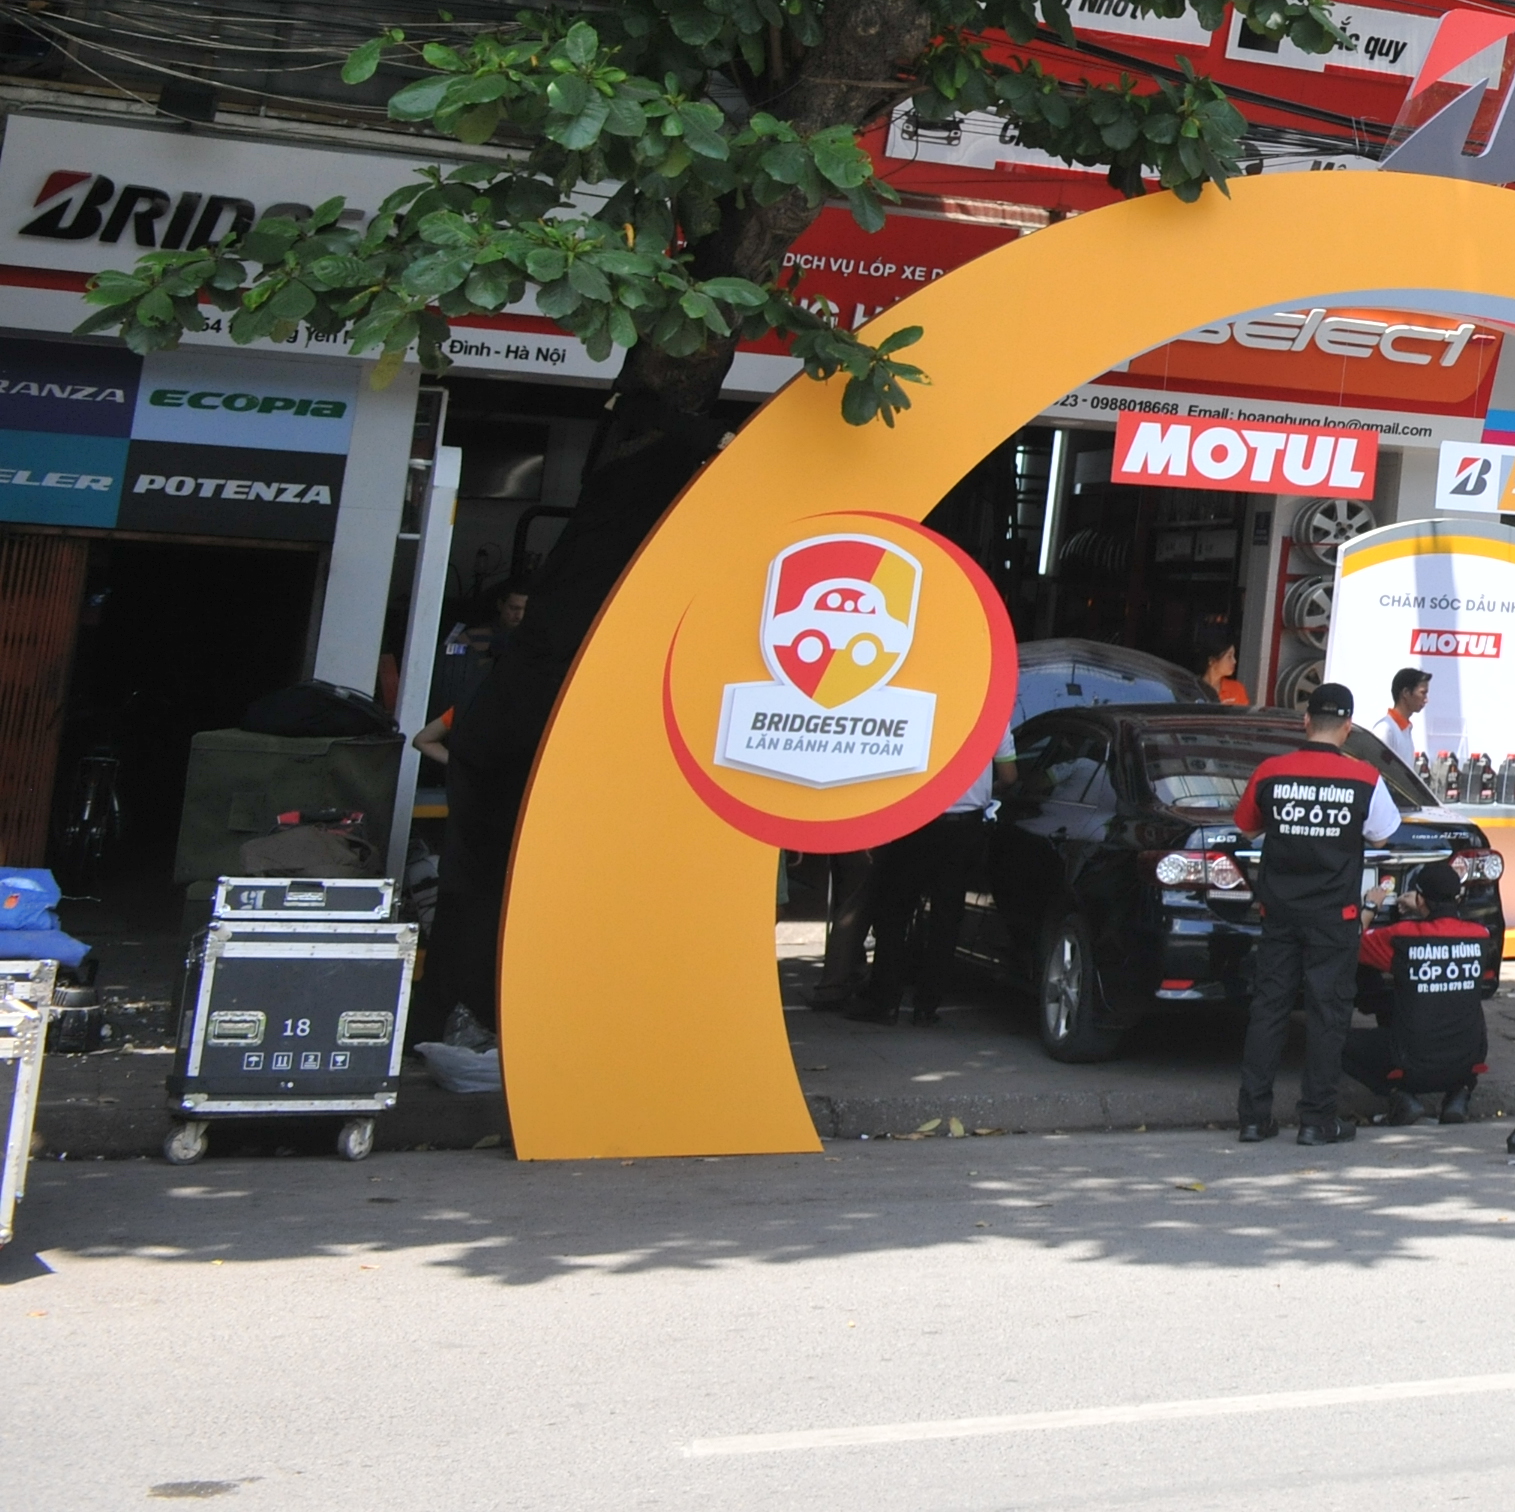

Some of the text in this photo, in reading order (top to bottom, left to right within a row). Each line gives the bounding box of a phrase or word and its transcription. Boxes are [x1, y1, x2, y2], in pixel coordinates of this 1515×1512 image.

[1363, 37, 1407, 64] quy
[829, 258, 855, 277] VỤ
[858, 257, 897, 277] LỐP
[901, 265, 927, 281] XE
[449, 339, 491, 358] Đình
[505, 344, 530, 361] Hà
[535, 348, 566, 364] Nội
[0, 379, 126, 404] ANZA
[1121, 421, 1365, 489] MOTUL
[132, 474, 332, 506] POTENZA
[1429, 593, 1461, 612] SÓC
[1413, 632, 1500, 656] MOTUL
[751, 712, 909, 738] BRIDGESTONE
[745, 734, 904, 757] LĂN BÁNH AN TOÀN
[1273, 781, 1355, 804] HOÀNG HÙNG
[1272, 800, 1351, 826] LỐP Ô TÔ
[1408, 941, 1482, 961] HOÀNG HÙNG
[1409, 959, 1481, 981] LỐP Ô TÔ
[283, 1018, 311, 1037] 18
